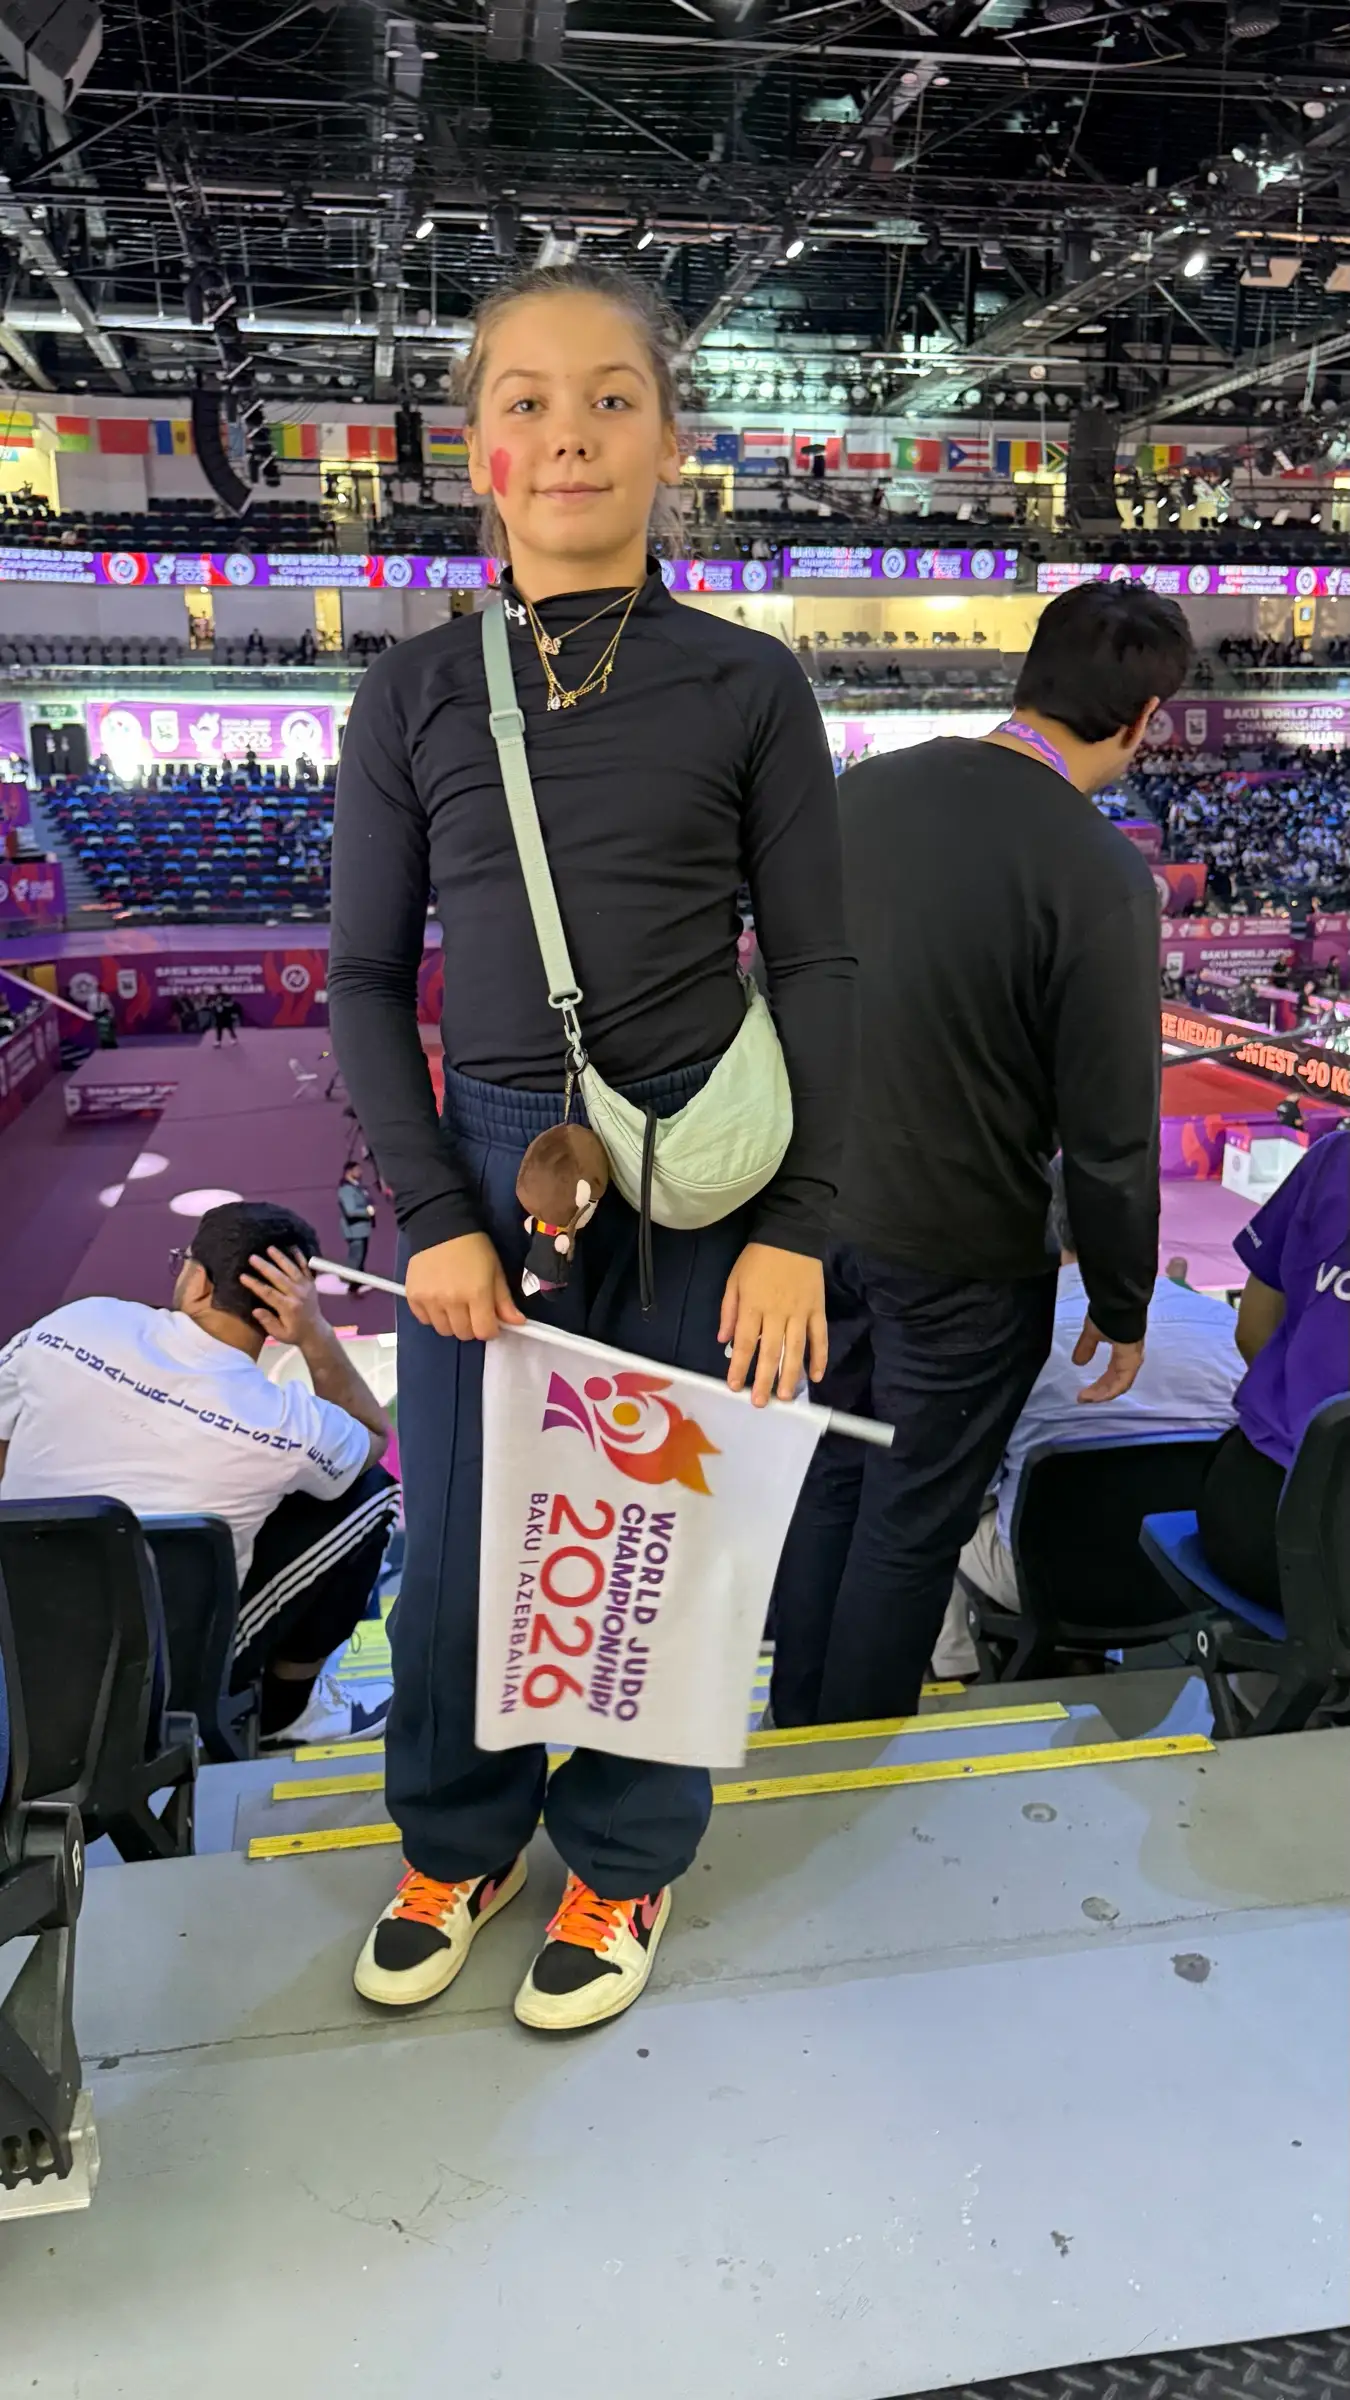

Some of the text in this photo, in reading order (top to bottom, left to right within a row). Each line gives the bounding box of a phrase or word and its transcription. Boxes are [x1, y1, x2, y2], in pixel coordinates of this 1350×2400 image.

[1223, 706, 1343, 719] BAKU WORLD JUDO
[1315, 1262, 1350, 1302] VO
[524, 1493, 548, 1551] BAKU
[499, 1572, 535, 1714] AZERBAIJAN
[522, 1494, 615, 1709] 2026
[588, 1503, 646, 1717] CHAMPIONSHIPS
[615, 1511, 676, 1721] WORLD JUDO
[1197, 1630, 1208, 1658] Q
